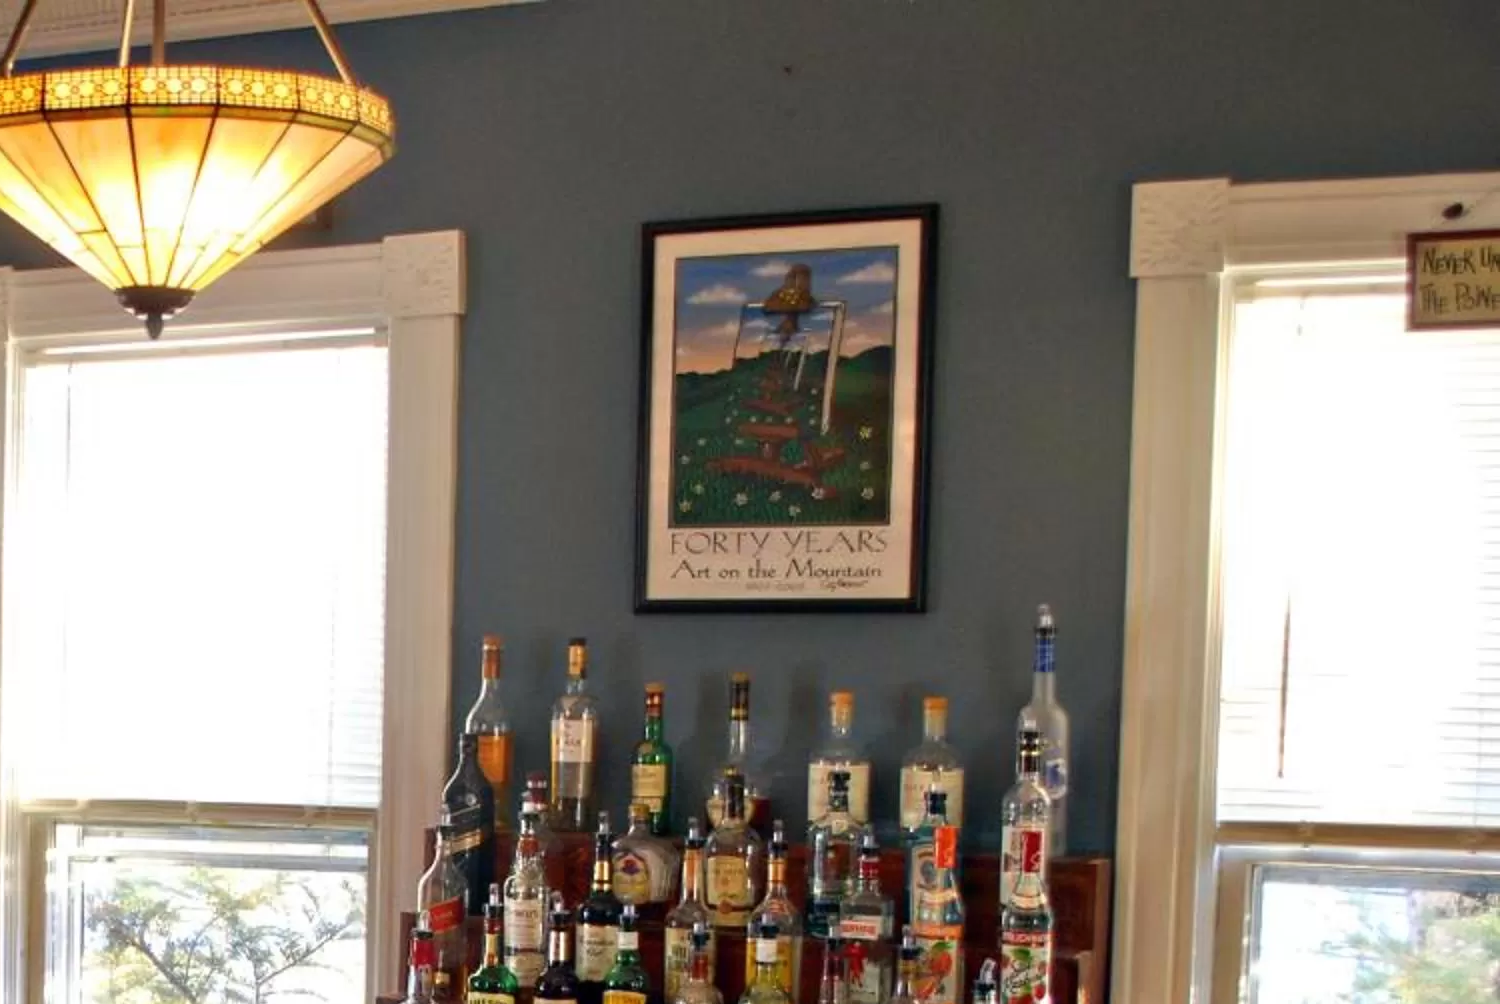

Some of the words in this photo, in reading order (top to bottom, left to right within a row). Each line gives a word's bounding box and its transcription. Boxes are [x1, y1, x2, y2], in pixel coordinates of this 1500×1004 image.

[669, 530, 771, 558] FORTY
[781, 529, 888, 558] YEARS
[669, 559, 711, 579] Art
[718, 567, 741, 579] on
[747, 559, 777, 579] the
[785, 557, 883, 579] Mountain
